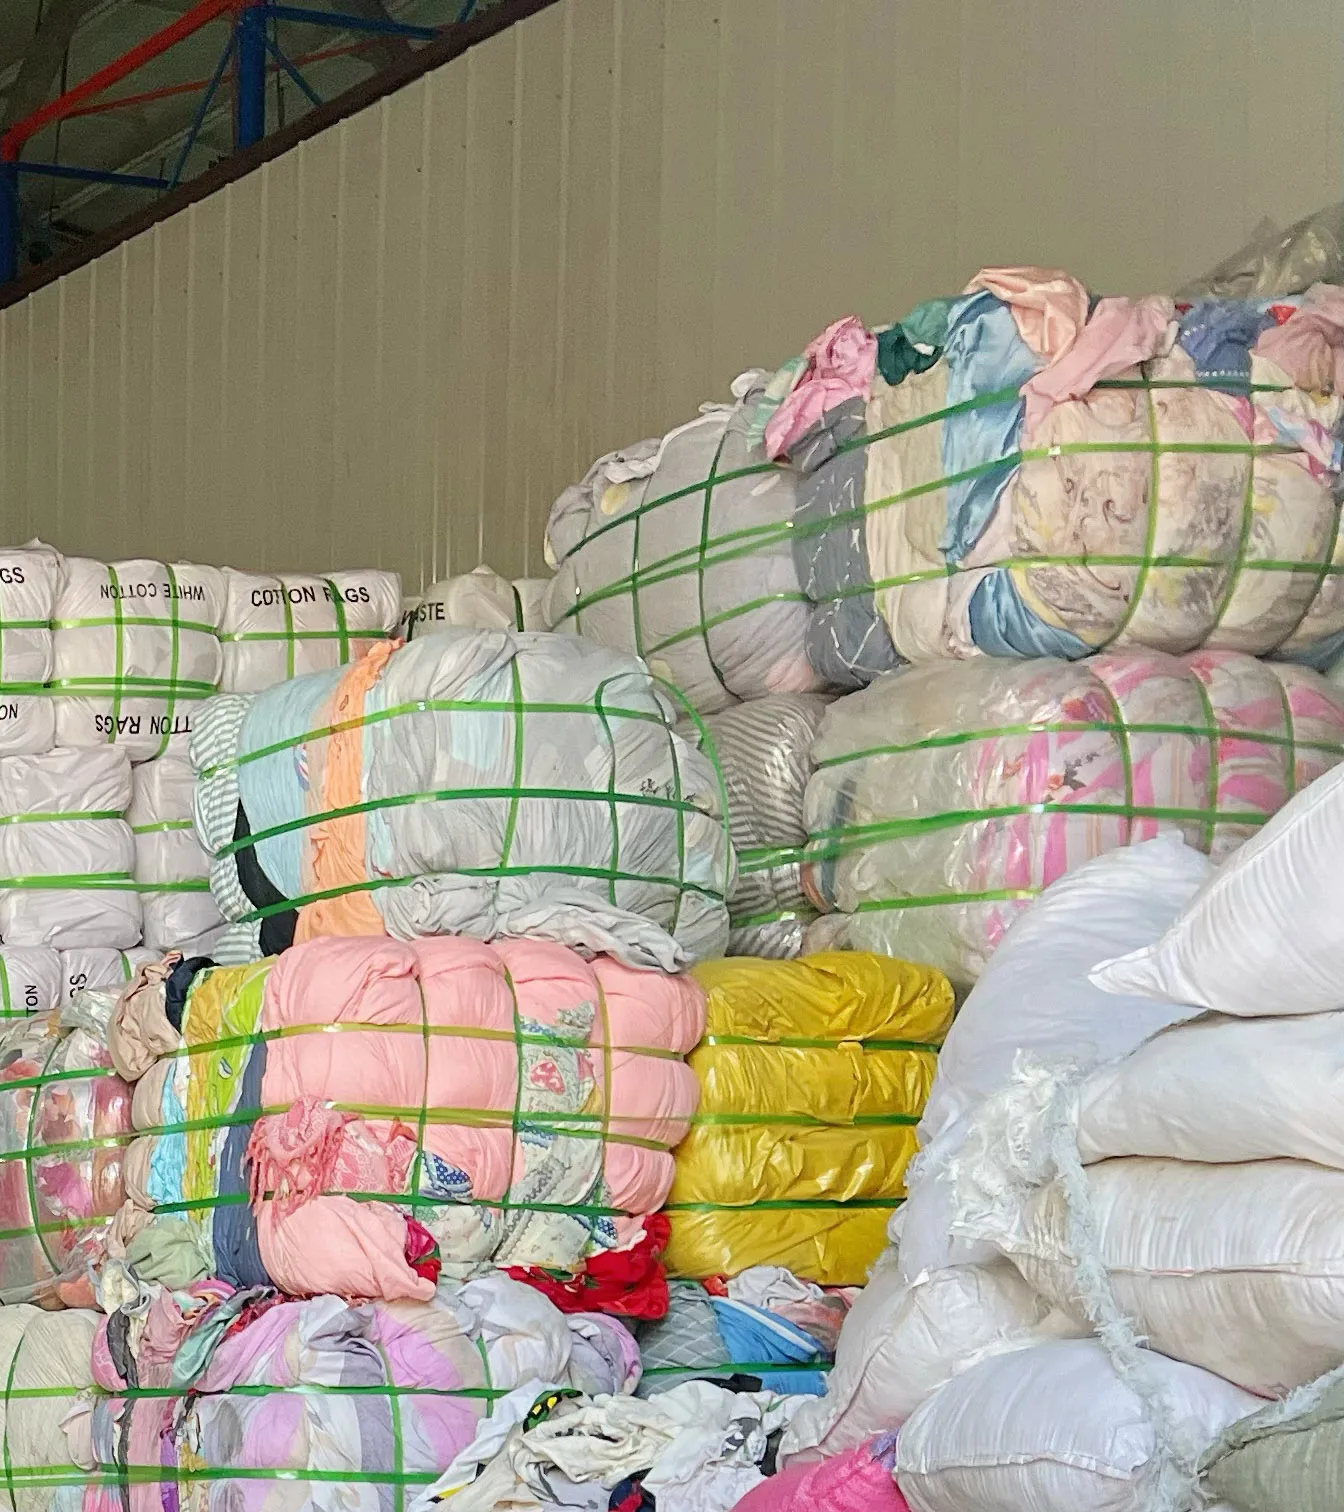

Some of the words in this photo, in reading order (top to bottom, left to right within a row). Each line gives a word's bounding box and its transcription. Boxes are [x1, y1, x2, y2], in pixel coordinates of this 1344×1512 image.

[100, 583, 157, 599] COTTON
[164, 583, 205, 600] WHITE
[95, 715, 141, 734] RAGS
